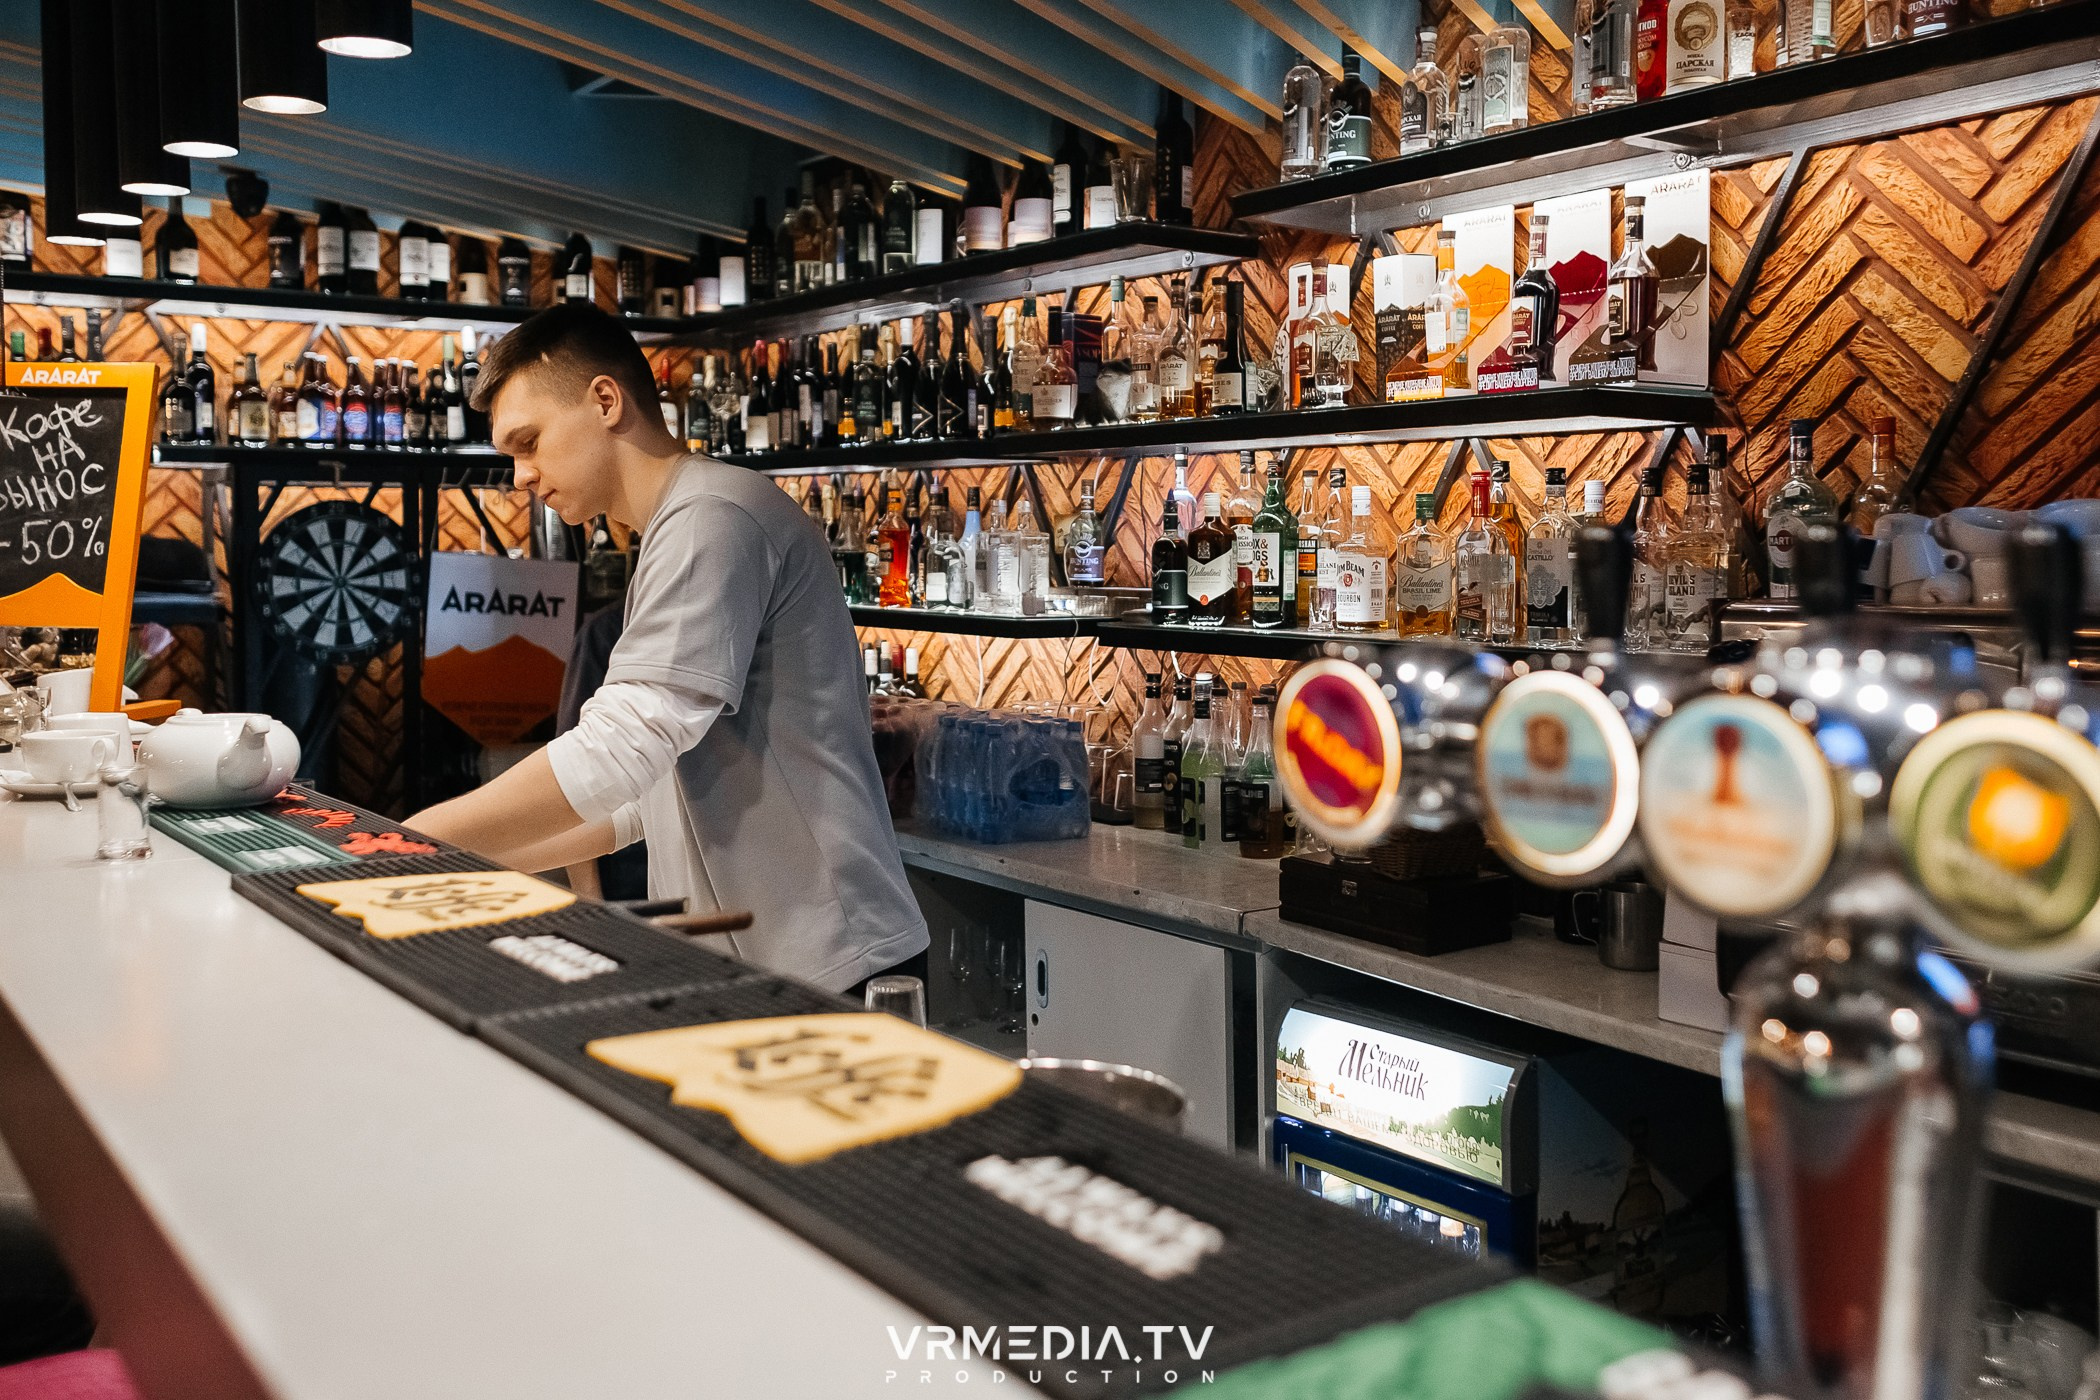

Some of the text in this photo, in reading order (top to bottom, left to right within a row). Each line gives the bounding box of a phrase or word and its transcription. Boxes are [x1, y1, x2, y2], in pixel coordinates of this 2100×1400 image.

[1676, 59, 1714, 69] ЦАРСКАЯ
[20, 367, 102, 385] ARARAT
[0, 399, 103, 451] Кофе
[32, 432, 86, 474] НА
[1345, 560, 1365, 578] BEAM
[1400, 574, 1444, 588] Ballantine's
[441, 586, 566, 618] ARARAT
[1338, 1039, 1429, 1101] Мельник
[1369, 1043, 1420, 1073] Старый
